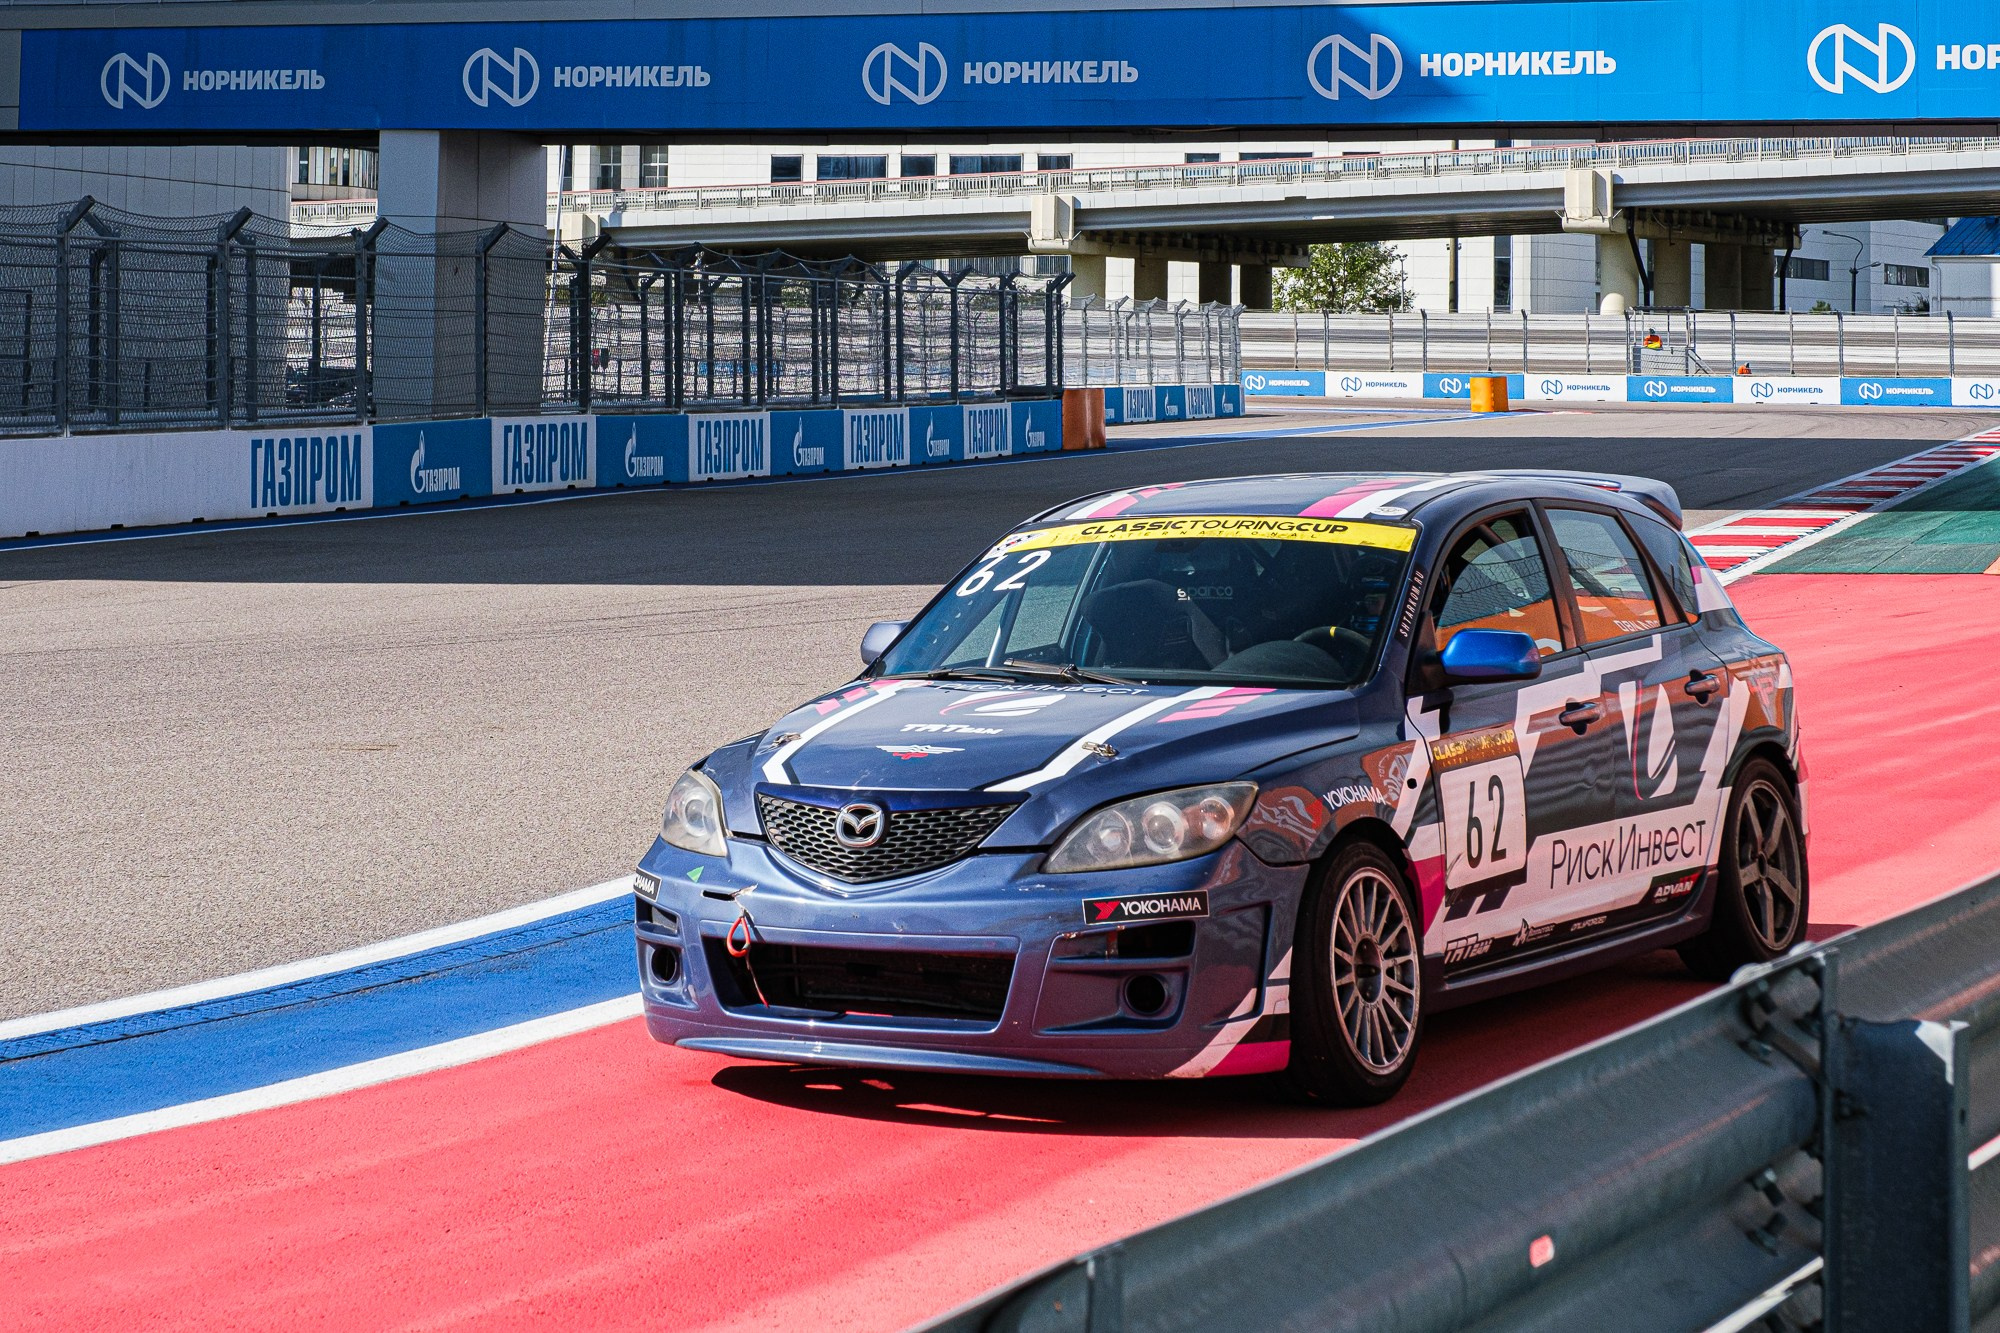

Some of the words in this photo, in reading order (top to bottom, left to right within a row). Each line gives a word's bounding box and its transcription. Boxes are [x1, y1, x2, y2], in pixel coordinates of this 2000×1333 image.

[554, 65, 711, 88] НОРНИКЕЛЬ
[963, 60, 1139, 85] НОРНИКЕЛЬ
[1420, 50, 1617, 77] НОРНИКЕЛЬ
[183, 69, 325, 91] НОРНИКЕЛЬ
[1268, 379, 1311, 388] НОРНИКЕЛЬ
[1365, 381, 1408, 389] НОРНИКЕЛЬ
[1670, 385, 1717, 394] НОРНИКЕЛЬ
[1885, 387, 1934, 395] НОРНИКЕЛЬ
[1126, 388, 1154, 419] ГАЗПРОМ
[1187, 387, 1214, 416] ГАЗПРОМ
[696, 417, 765, 475] ГАЗПРОМ
[850, 412, 905, 464] ГАЗПРОМ
[968, 407, 1009, 458] ГАЗПРОМ
[502, 421, 588, 487] ГАЗПРОМ
[636, 455, 664, 477] ГАЗПРОМ
[250, 434, 362, 509] ГАЗПРОМ
[425, 466, 460, 493] ГАЗПРОМ
[956, 550, 1052, 597] 62
[1399, 570, 1425, 637] SHTARKOM.RU
[1322, 784, 1387, 810] YOKOHAMA
[1466, 774, 1507, 869] 62
[1653, 880, 1694, 898] ADVAN
[1120, 897, 1202, 916] YOKOHAMA
